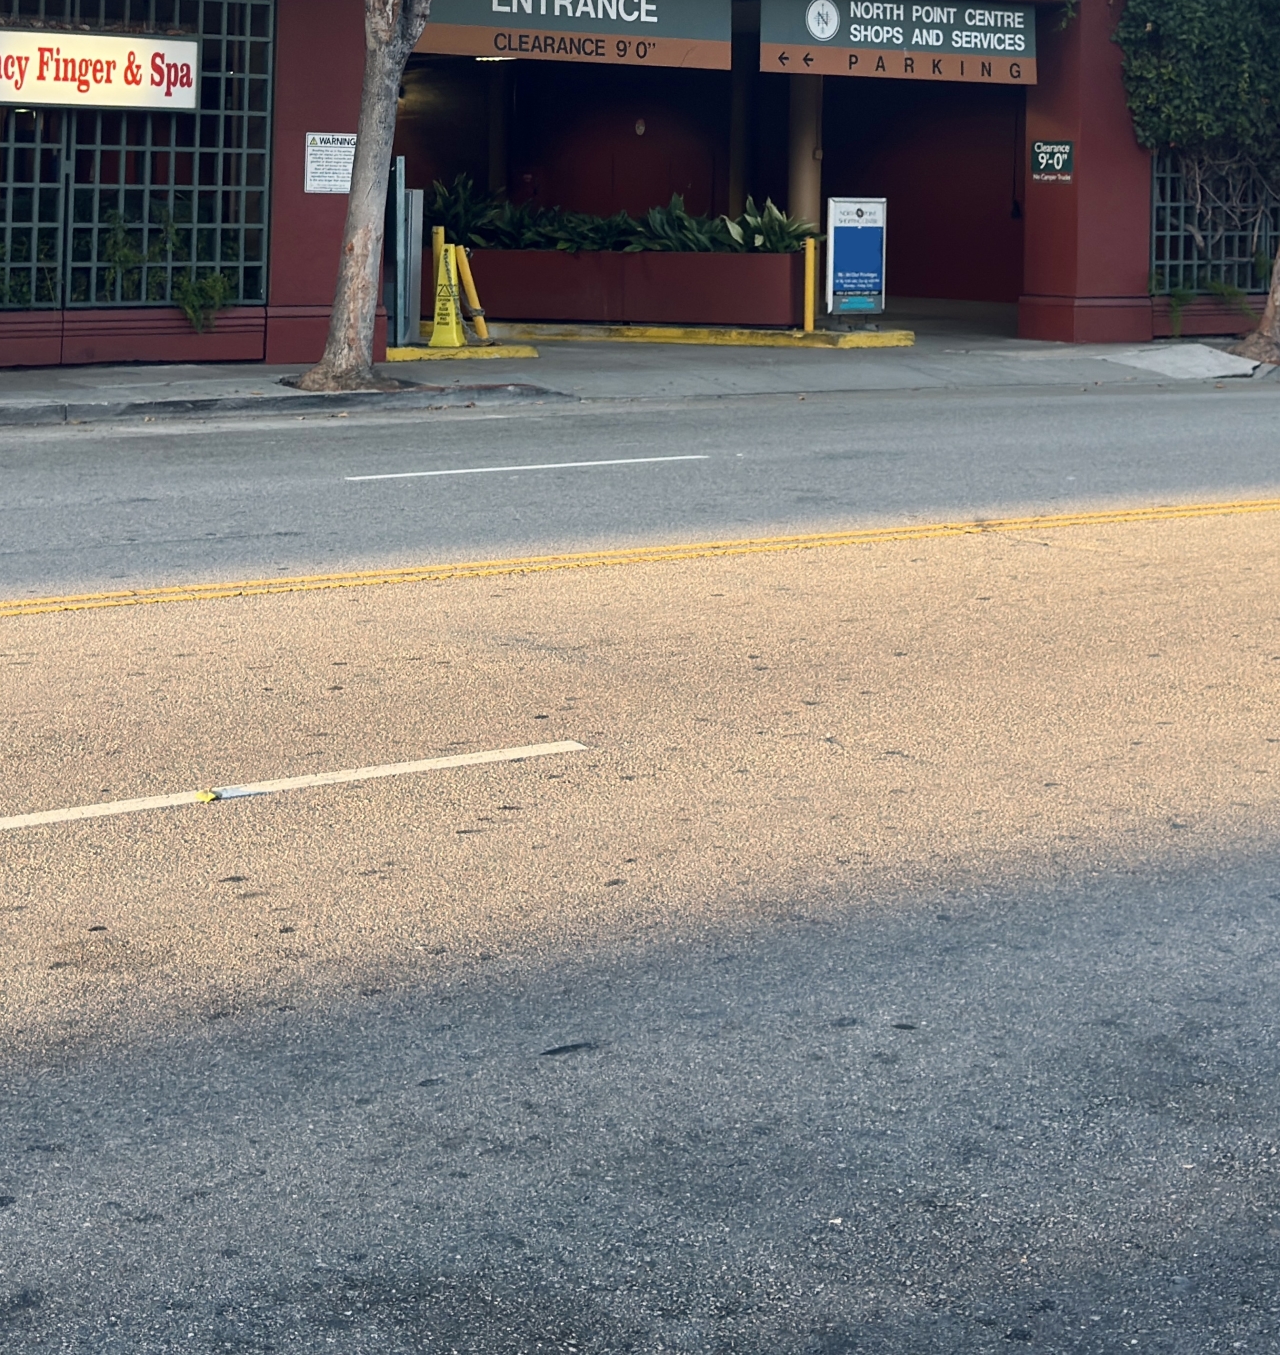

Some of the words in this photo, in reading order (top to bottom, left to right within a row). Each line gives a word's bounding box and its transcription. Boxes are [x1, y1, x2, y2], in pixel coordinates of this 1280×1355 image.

[850, 1, 904, 21] NORTH
[912, 5, 957, 25] POINT
[964, 9, 1024, 28] CENTRE
[494, 32, 606, 57] CLEARANCE
[850, 24, 904, 44] SHOPS
[911, 28, 943, 46] AND
[951, 31, 1025, 51] SERVICES
[36, 47, 116, 93] Finger
[123, 51, 142, 86] &
[150, 52, 193, 97] Spa
[319, 136, 357, 146] WARNING
[1034, 142, 1070, 153] Clearance
